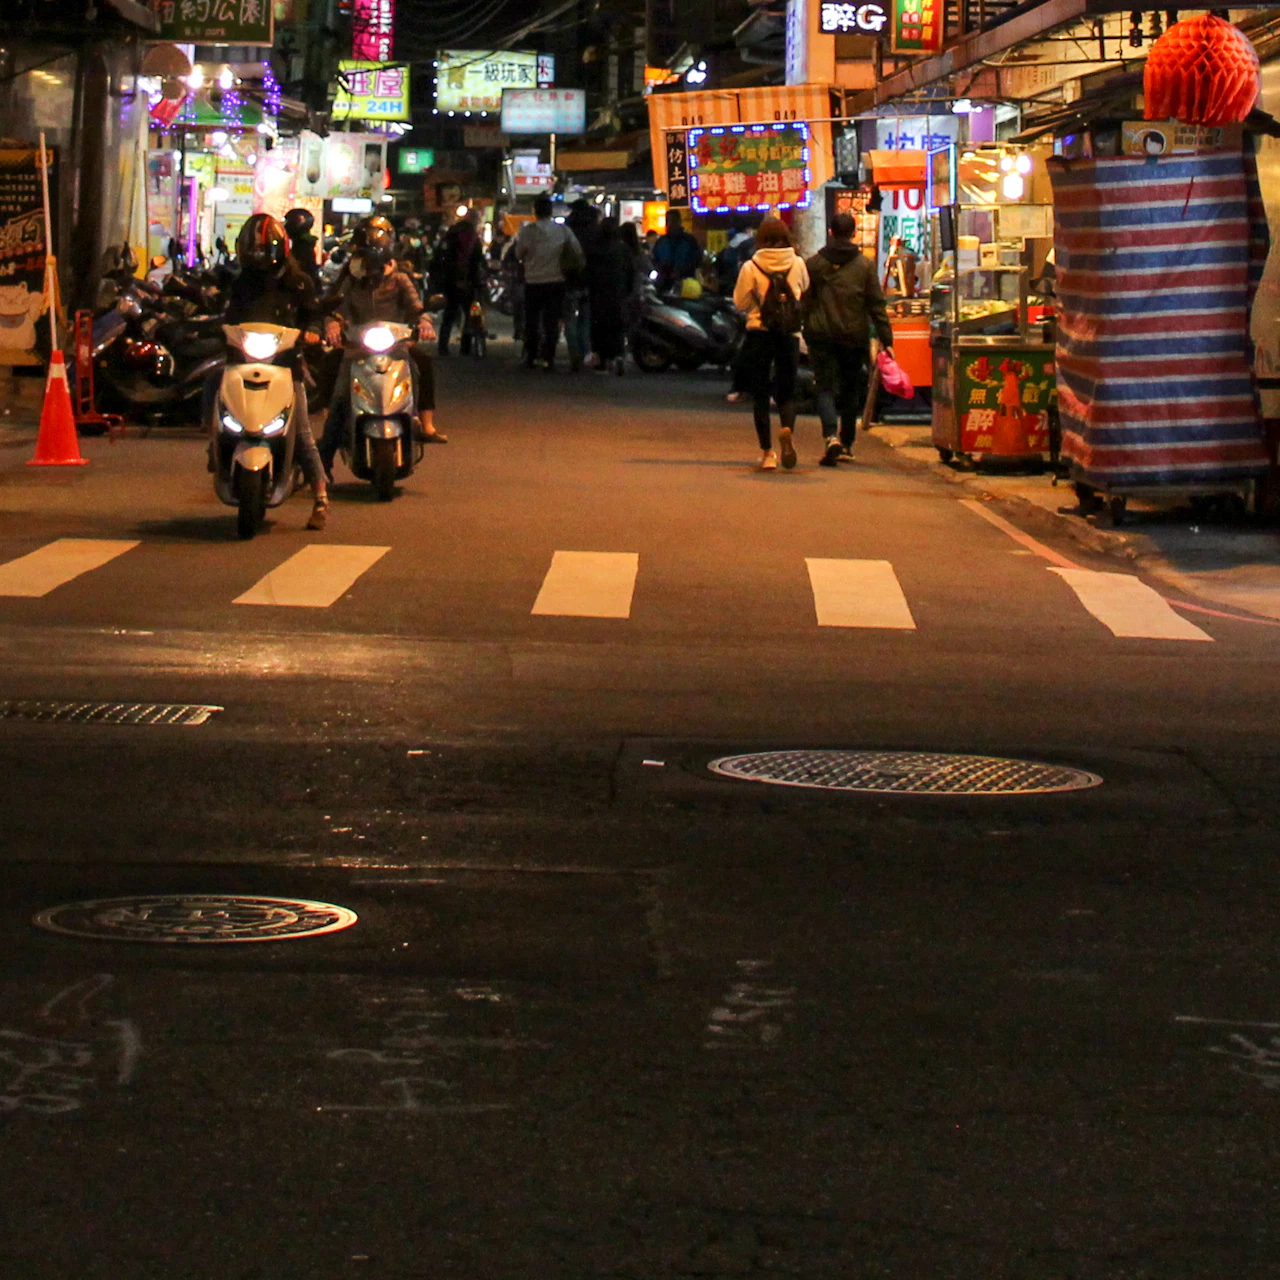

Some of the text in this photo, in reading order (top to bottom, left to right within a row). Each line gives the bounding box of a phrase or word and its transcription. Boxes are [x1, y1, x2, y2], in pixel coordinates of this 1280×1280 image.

[821, 2, 888, 32] 醉G
[467, 62, 535, 84] 一級玩家
[366, 100, 404, 113] 24H
